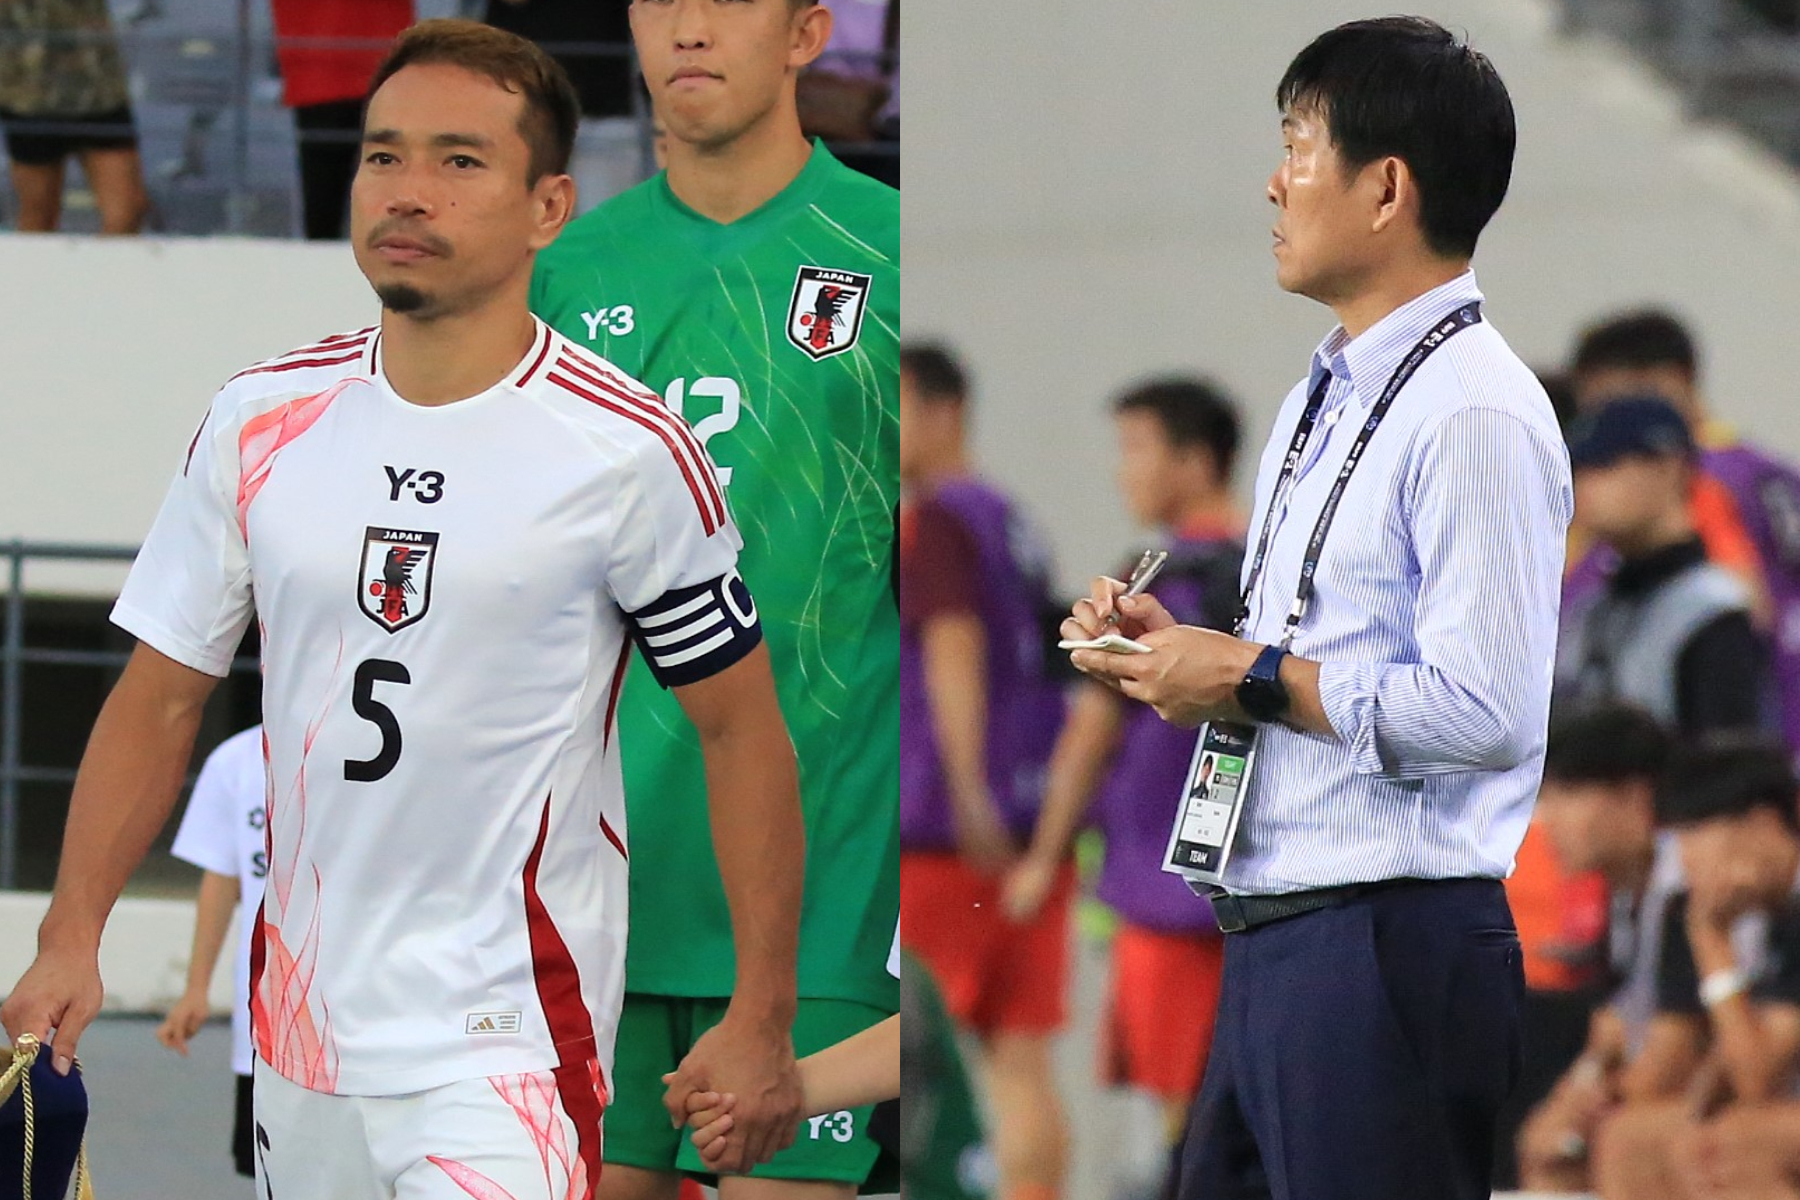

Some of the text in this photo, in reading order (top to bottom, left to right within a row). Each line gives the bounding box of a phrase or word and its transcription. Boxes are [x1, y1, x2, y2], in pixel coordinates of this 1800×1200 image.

[815, 271, 854, 284] JAPAN
[580, 304, 635, 341] Y-3
[803, 327, 835, 345] JFA
[383, 465, 446, 504] Y-3
[382, 530, 423, 542] JAPAN
[375, 598, 410, 617] JFA
[344, 658, 411, 783] 5
[1189, 850, 1209, 865] TEAM
[807, 1110, 854, 1143] Y-3
